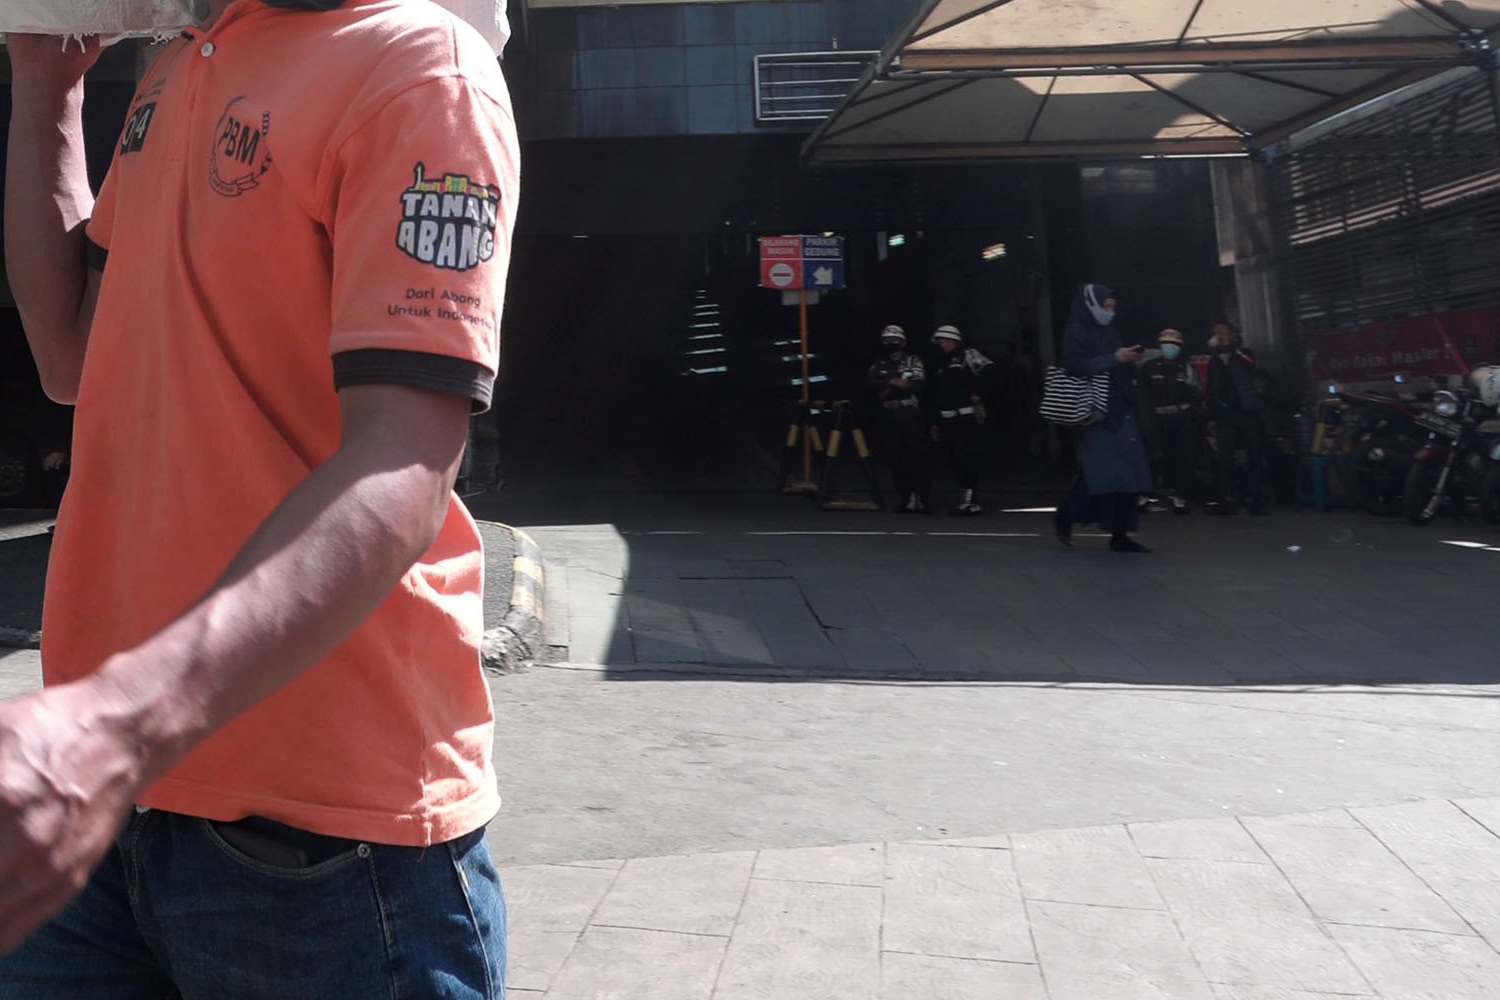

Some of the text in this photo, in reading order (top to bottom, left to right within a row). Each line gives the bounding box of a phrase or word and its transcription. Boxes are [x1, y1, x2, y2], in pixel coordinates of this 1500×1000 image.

[122, 109, 149, 146] 04
[219, 117, 261, 167] PBM
[398, 221, 494, 268] ABANG
[387, 304, 431, 319] Untuk
[406, 287, 481, 308] Dari Abang
